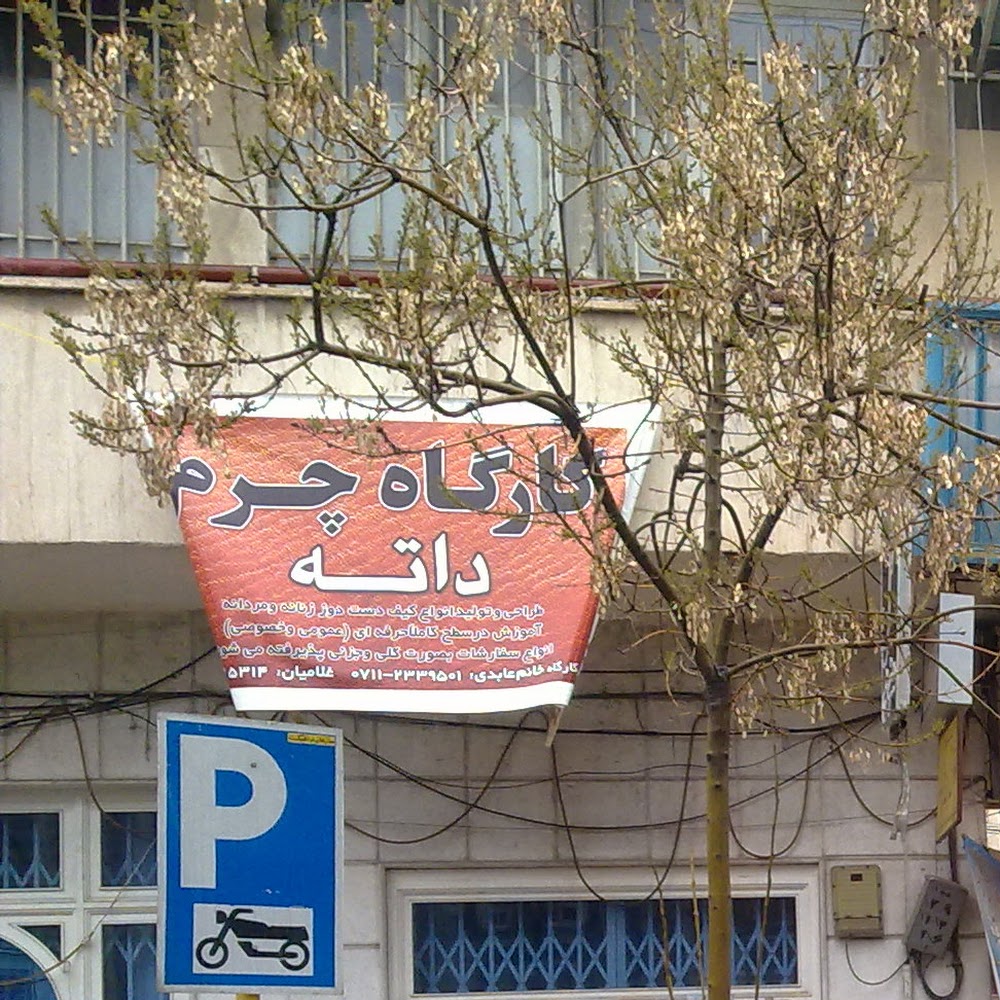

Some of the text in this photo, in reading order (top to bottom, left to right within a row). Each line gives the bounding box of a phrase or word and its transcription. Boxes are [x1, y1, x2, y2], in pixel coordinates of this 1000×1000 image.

[171, 440, 608, 537] کارگاه چرم
[288, 531, 492, 597] داته
[317, 601, 344, 617] دوز
[387, 603, 417, 620] کیف
[503, 604, 545, 621] طراحی
[492, 622, 544, 642] آموزش
[266, 642, 326, 661] پذیرفته
[455, 647, 521, 662] سفارشات
[180, 734, 287, 889] P
